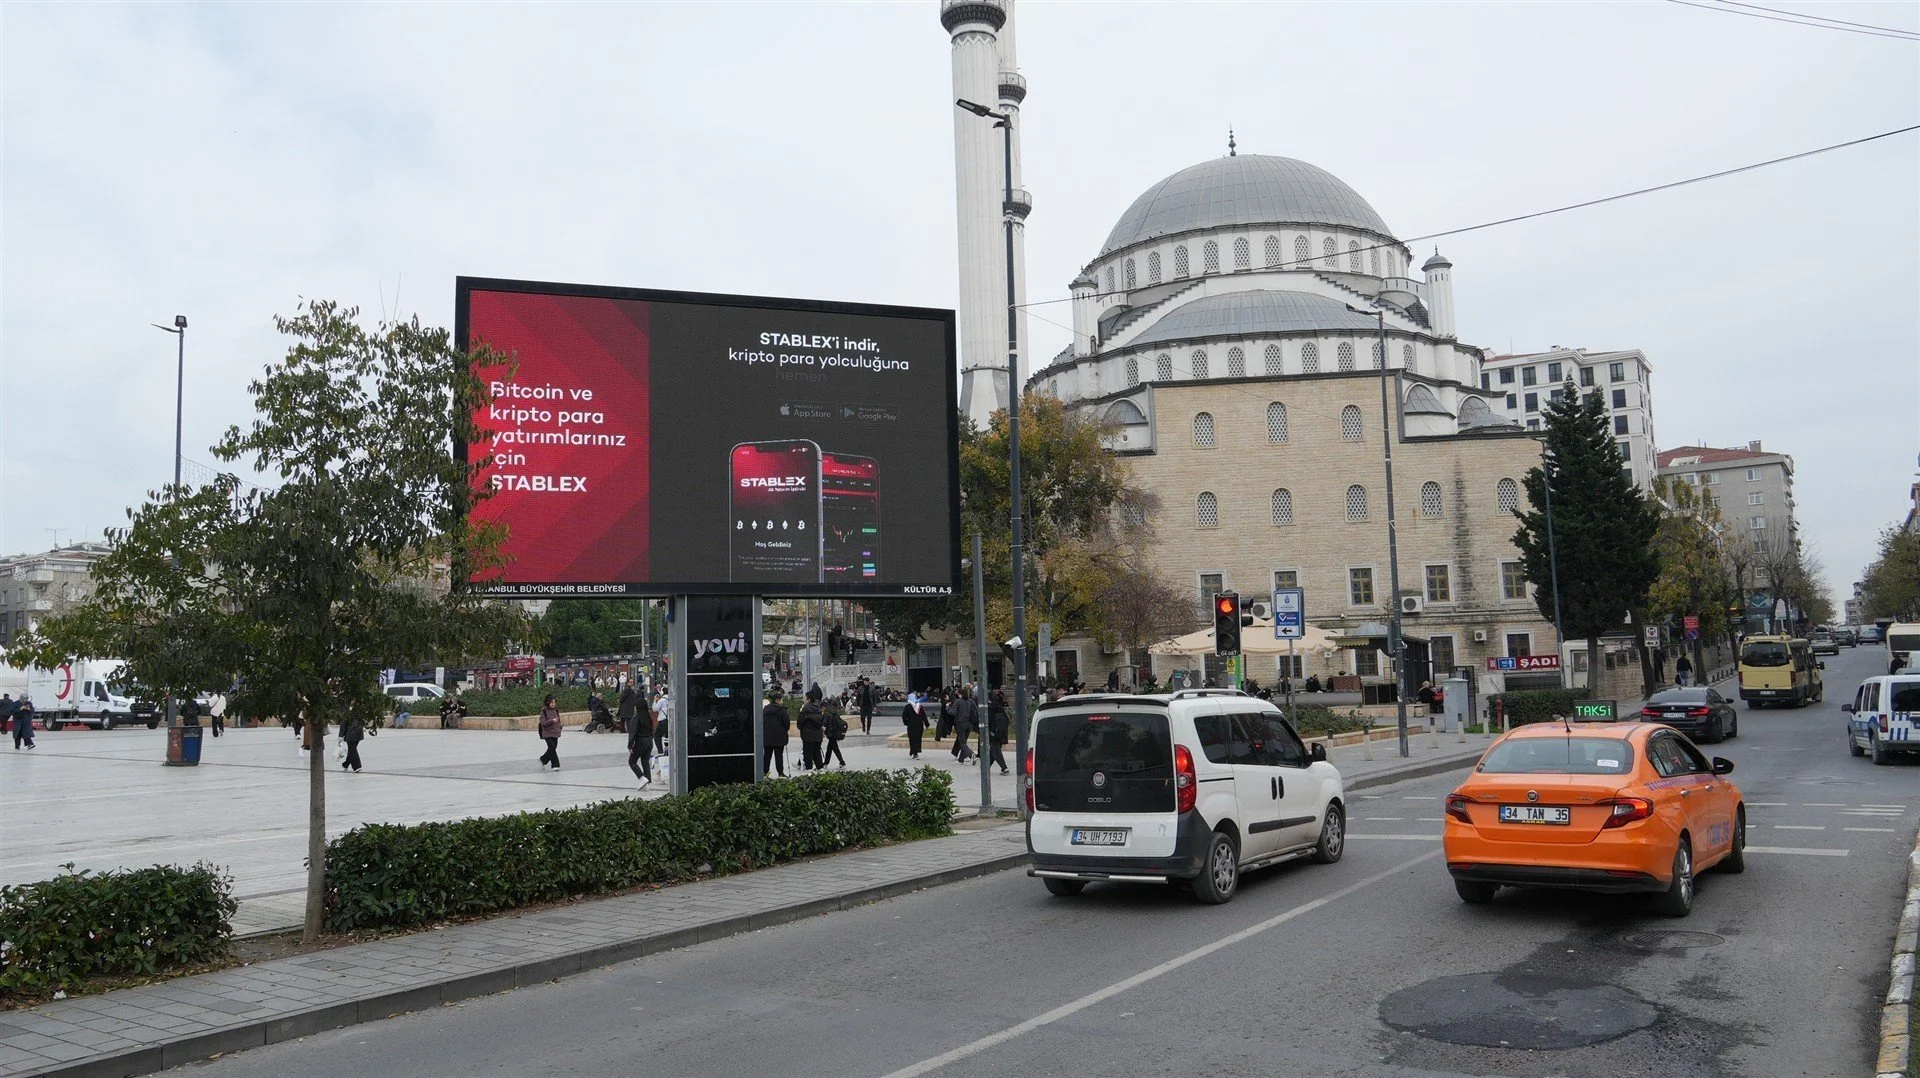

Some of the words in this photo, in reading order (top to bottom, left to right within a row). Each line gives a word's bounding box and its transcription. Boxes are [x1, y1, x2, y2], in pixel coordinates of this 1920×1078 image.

[844, 337, 880, 353] indir,
[729, 347, 775, 365] kripto
[780, 353, 814, 366] para
[819, 354, 910, 372] yolculuğuna
[491, 381, 563, 399] Bitcoin
[570, 388, 592, 401] ve
[490, 404, 551, 425] kripto
[558, 411, 603, 427] para
[794, 410, 810, 418] App
[811, 410, 831, 418] Store
[858, 412, 881, 421] Google
[492, 429, 626, 447] yatırımlarınız
[491, 474, 587, 492] STABLEX
[741, 476, 806, 487] STABLEX
[520, 584, 575, 594] BÜYÜKŞEHİR
[577, 584, 626, 593] BELEDİYESİ
[904, 585, 937, 593] KÜLTÜR
[693, 631, 745, 659] yovi
[1506, 807, 1518, 818] 34
[1526, 808, 1545, 819] TAN
[1555, 809, 1568, 820] 35
[1077, 832, 1087, 841] 34
[1090, 832, 1101, 841] UH
[1102, 832, 1123, 842] 7193
